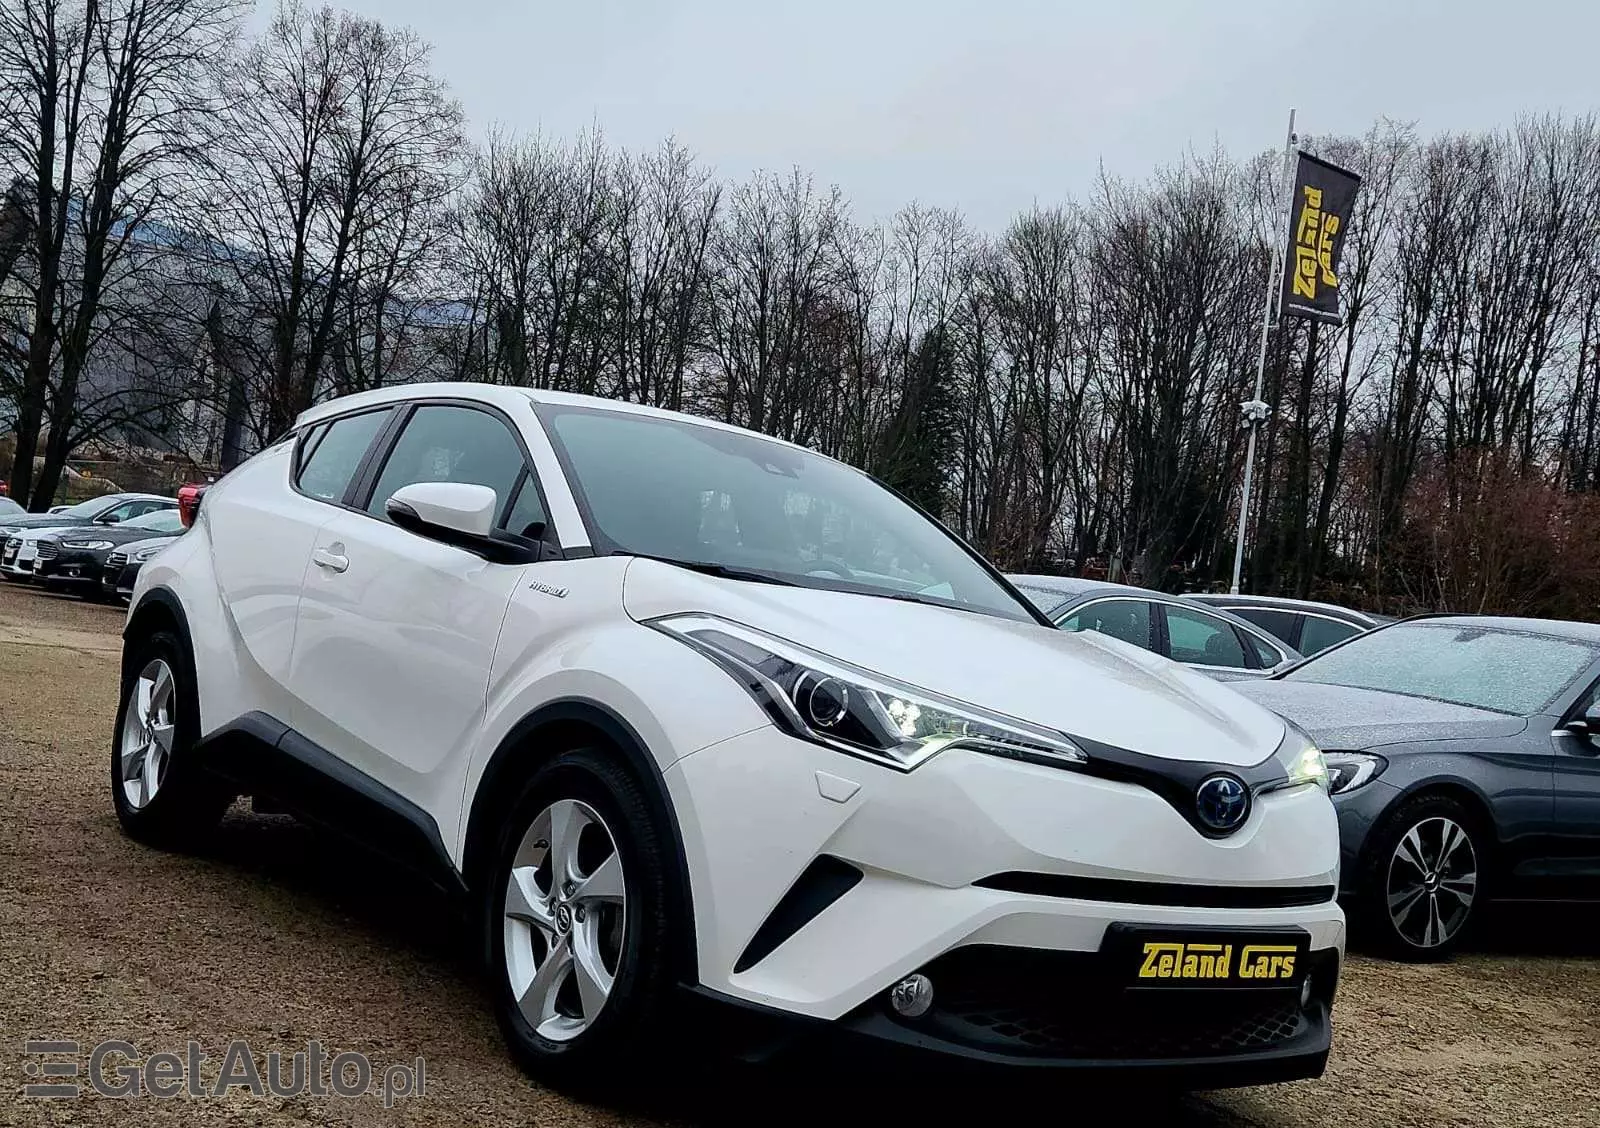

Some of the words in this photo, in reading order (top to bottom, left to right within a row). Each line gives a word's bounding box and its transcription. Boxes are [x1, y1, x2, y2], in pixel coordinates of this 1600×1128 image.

[1293, 185, 1322, 300] Zeland
[1318, 212, 1340, 288] Cars
[1138, 943, 1232, 978] Zeland
[1238, 945, 1297, 979] Cars
